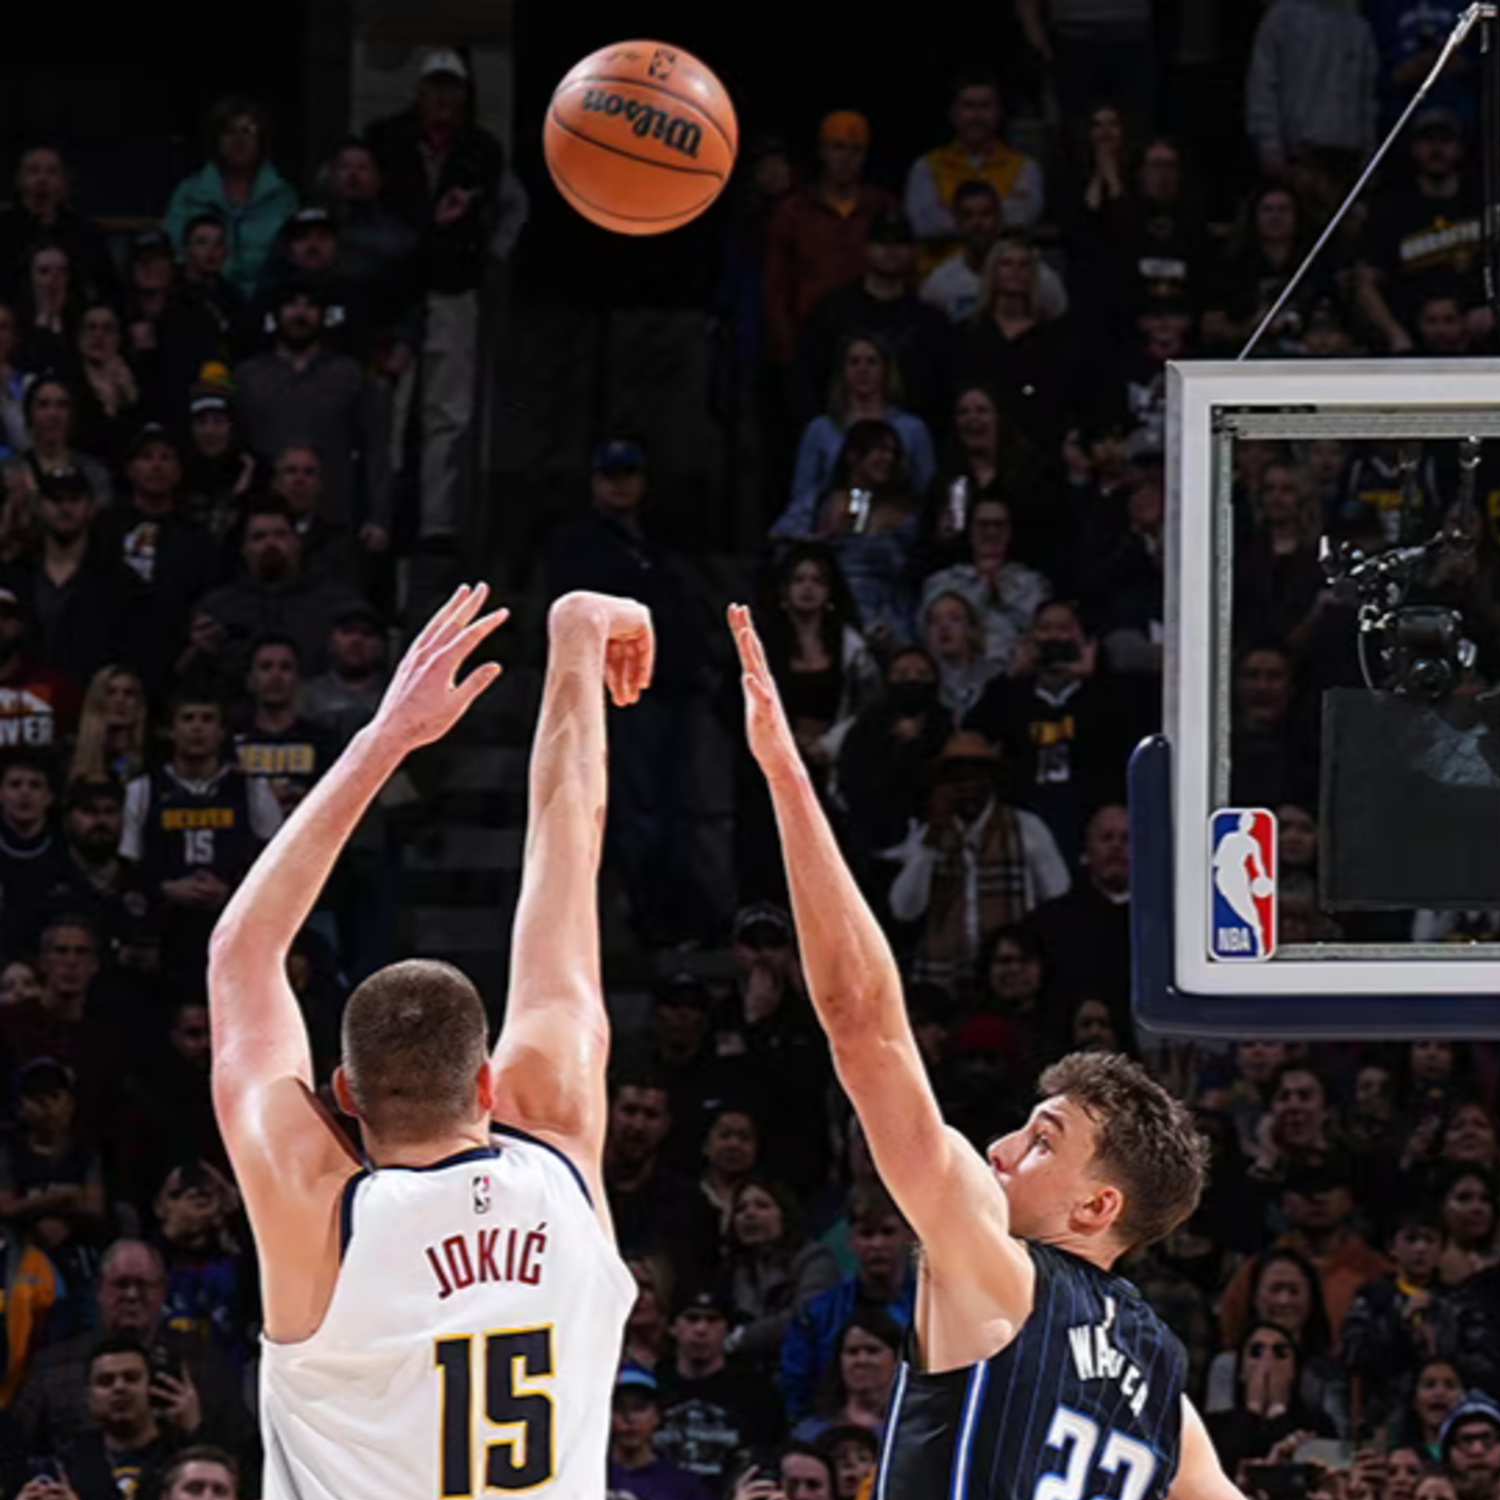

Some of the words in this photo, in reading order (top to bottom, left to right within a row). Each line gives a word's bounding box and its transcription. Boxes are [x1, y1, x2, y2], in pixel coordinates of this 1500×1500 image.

[583, 89, 703, 158] Wilson
[184, 829, 216, 865] 15
[1216, 926, 1252, 952] NBA
[425, 1222, 547, 1300] JOKIĆ
[433, 1322, 555, 1500] 15
